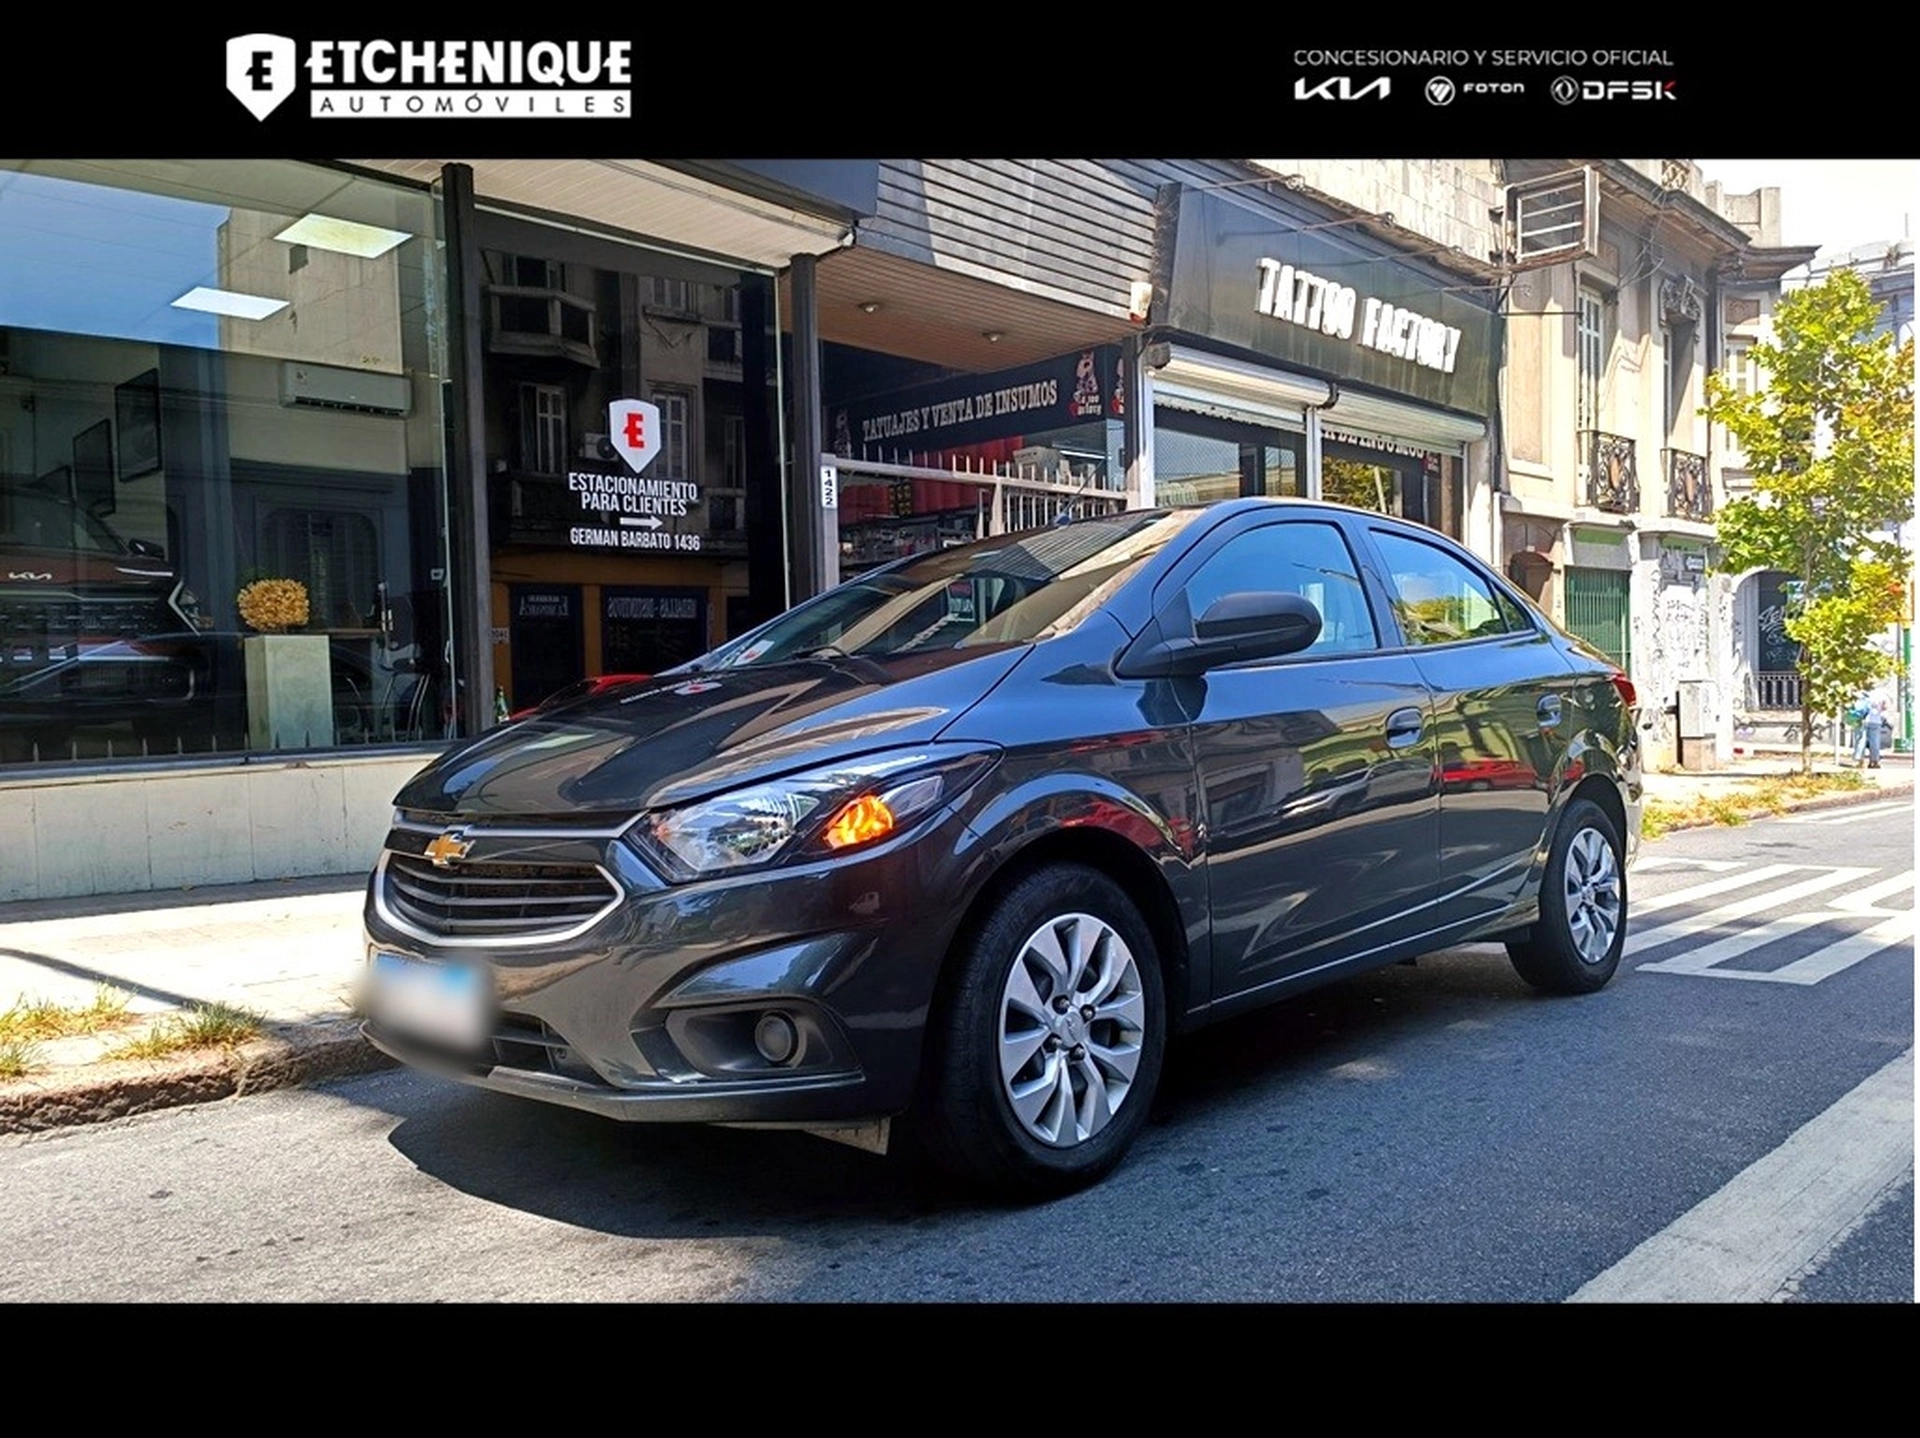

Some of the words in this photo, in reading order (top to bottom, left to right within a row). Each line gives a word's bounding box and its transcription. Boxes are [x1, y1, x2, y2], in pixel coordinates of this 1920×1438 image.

[1255, 257, 1357, 340] TATTOO
[1358, 297, 1462, 373] FACTORY
[862, 409, 920, 442] TATUAJES
[920, 407, 931, 430] Y
[931, 398, 975, 428] VENTA
[976, 392, 994, 418] DE
[995, 379, 1058, 414] INSUMOS
[568, 472, 698, 501] ESTACIONAMIENTO
[824, 469, 834, 506] 1422
[582, 491, 620, 511] PARA
[623, 494, 687, 516] CLIENTES
[570, 527, 619, 547] GERMAN
[620, 530, 671, 550] BARBATO
[673, 534, 701, 551] 1436
